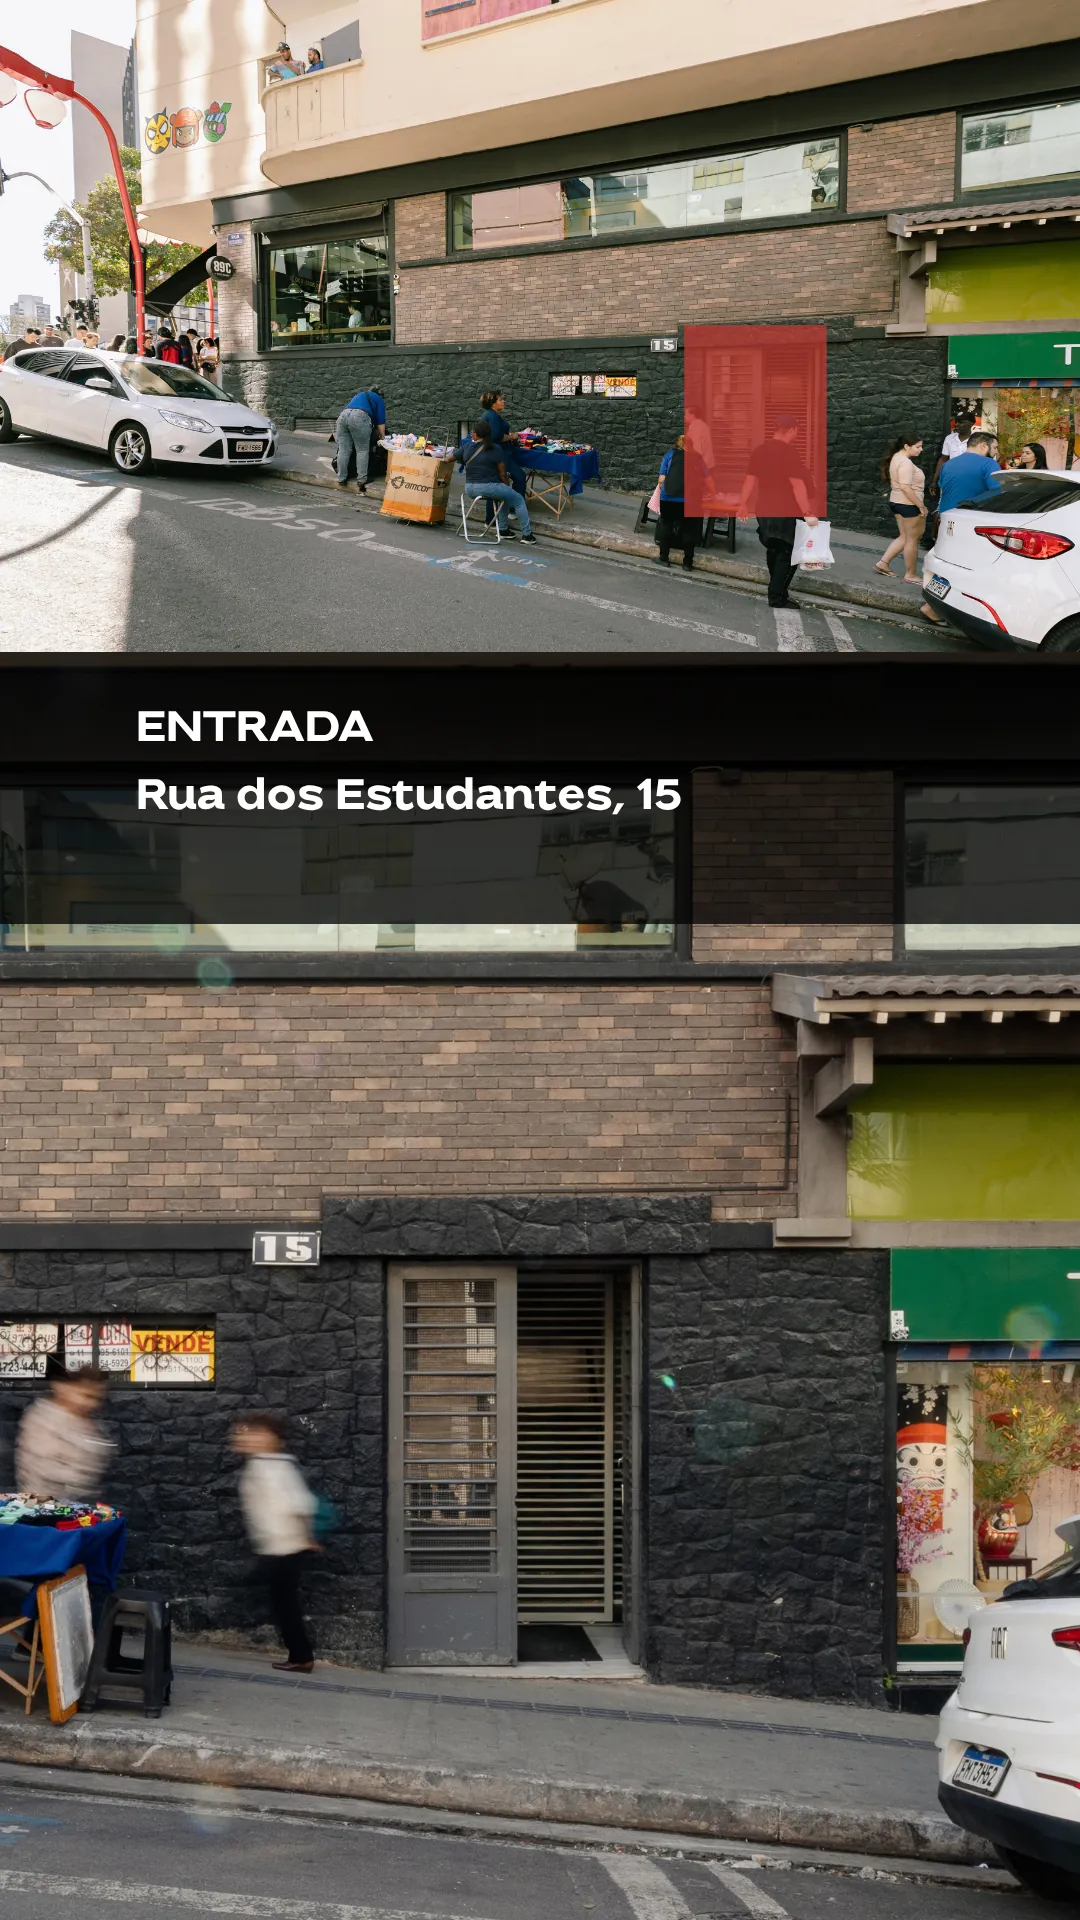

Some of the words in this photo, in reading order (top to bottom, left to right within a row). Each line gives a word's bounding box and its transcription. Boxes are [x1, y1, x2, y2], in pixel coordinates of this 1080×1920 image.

[652, 340, 675, 351] 15
[404, 482, 432, 493] amcor
[184, 497, 377, 542] IDOSO
[502, 555, 547, 567] 60+
[260, 1236, 312, 1261] 15
[135, 1334, 211, 1352] VENDE
